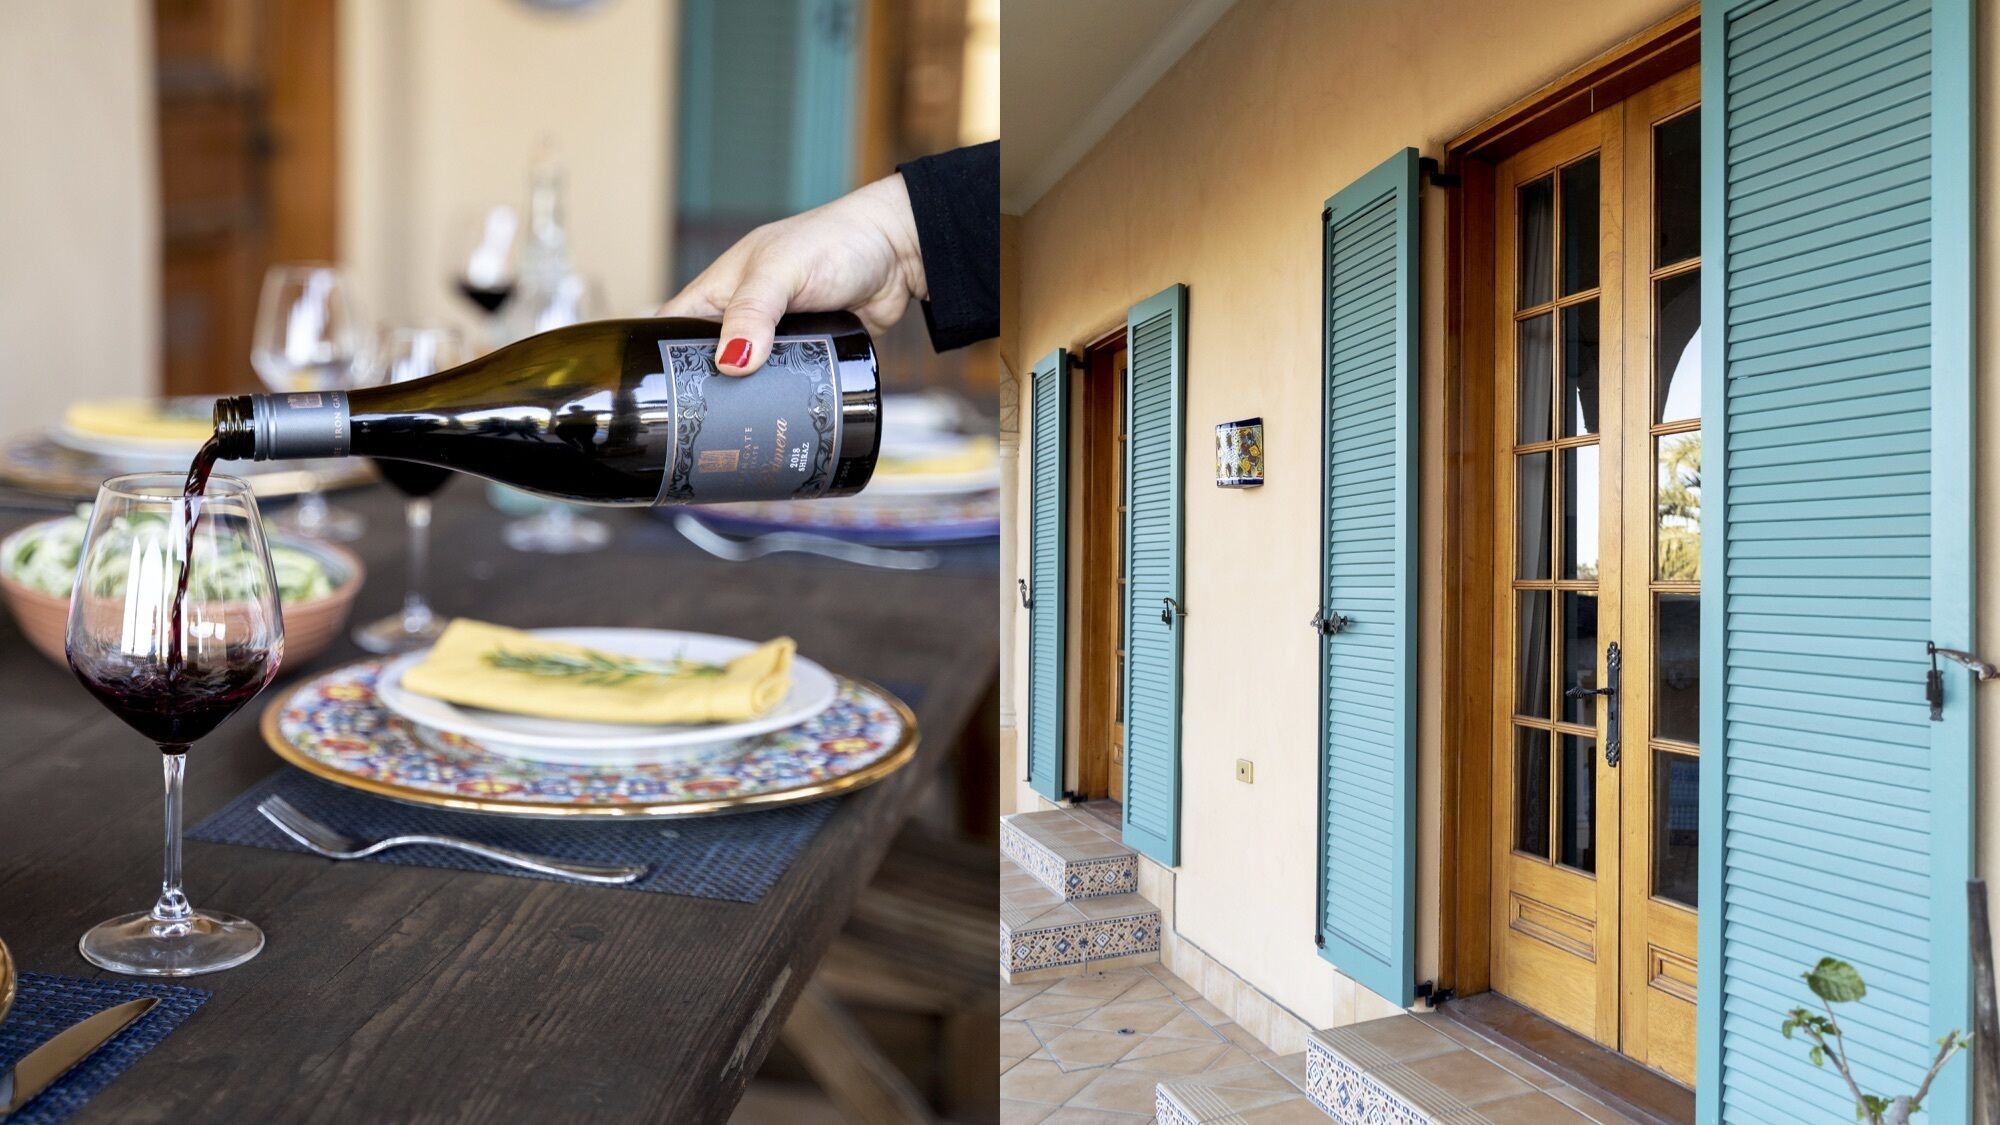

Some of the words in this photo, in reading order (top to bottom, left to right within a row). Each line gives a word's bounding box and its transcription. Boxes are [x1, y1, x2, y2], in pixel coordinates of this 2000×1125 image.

[334, 412, 343, 439] IRON
[743, 427, 752, 459] GATE
[798, 441, 810, 472] SHIRAZ
[789, 447, 801, 469] 2018
